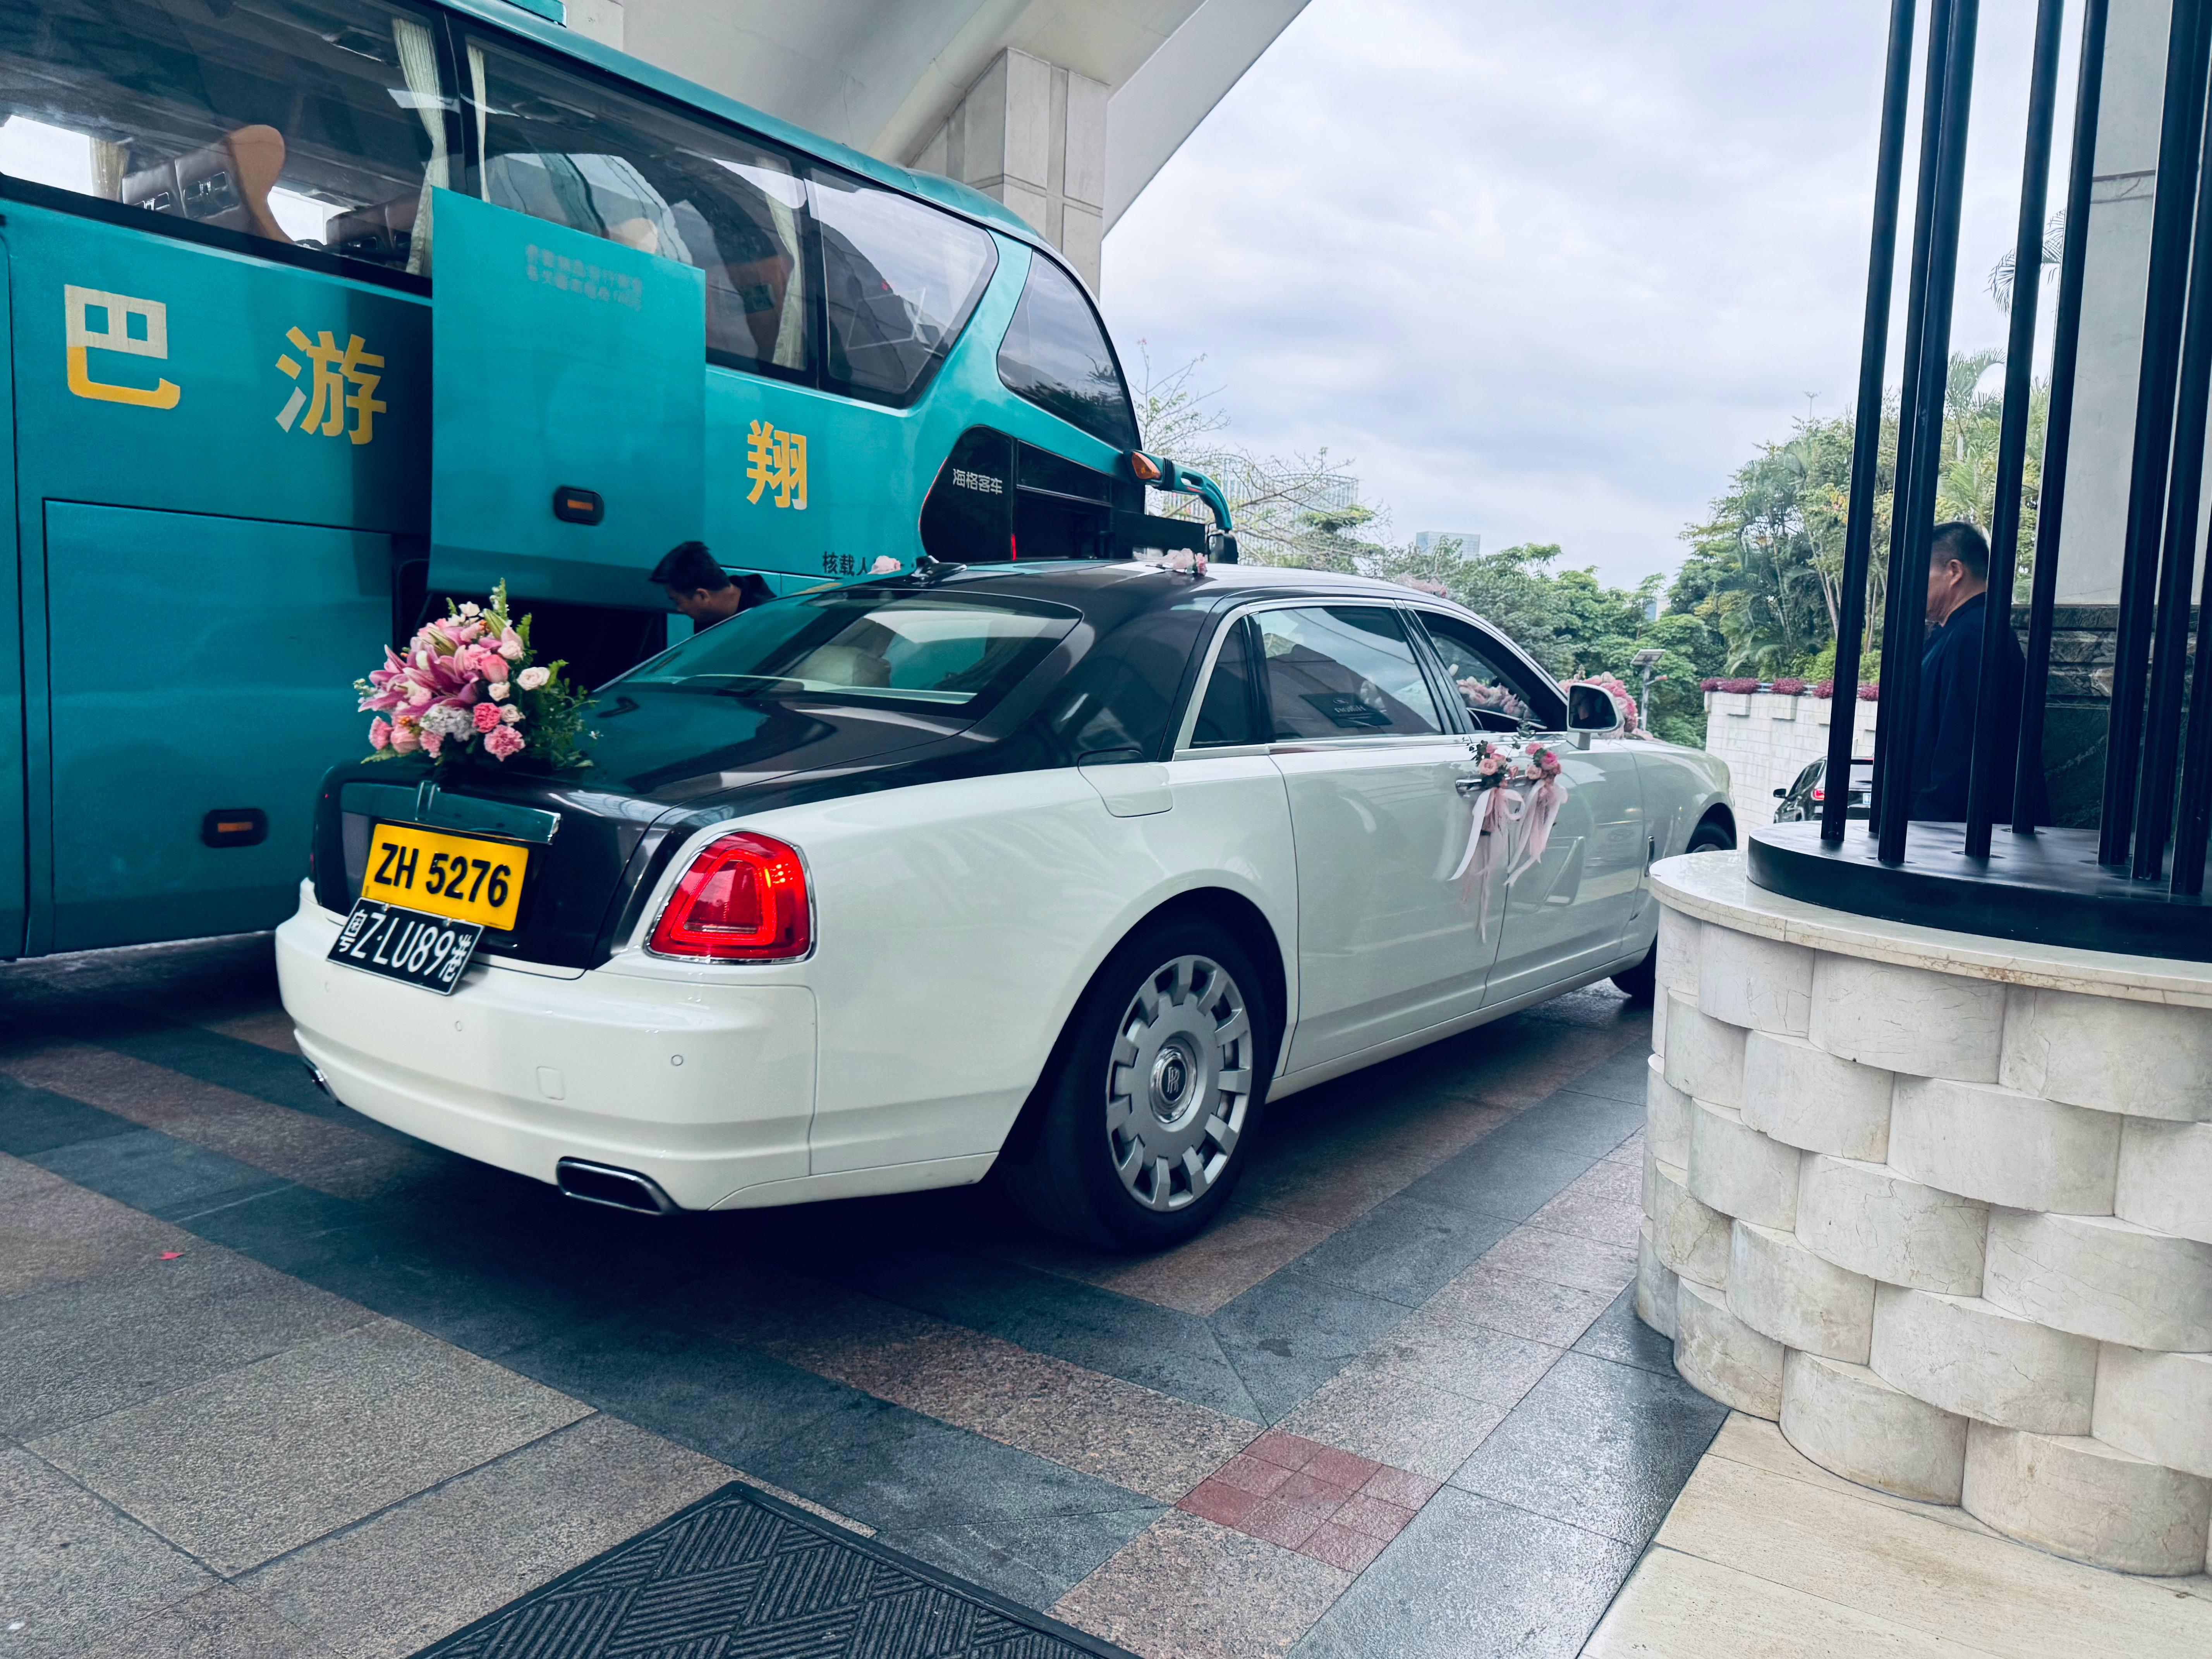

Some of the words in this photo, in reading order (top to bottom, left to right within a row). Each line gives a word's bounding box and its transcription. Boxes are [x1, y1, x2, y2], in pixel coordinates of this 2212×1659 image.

[64, 284, 180, 409] 巴
[275, 326, 387, 445] 游
[746, 419, 807, 510] 翔
[953, 468, 1003, 495] 海格客车
[374, 842, 419, 890] ZH
[426, 852, 511, 908] 5276
